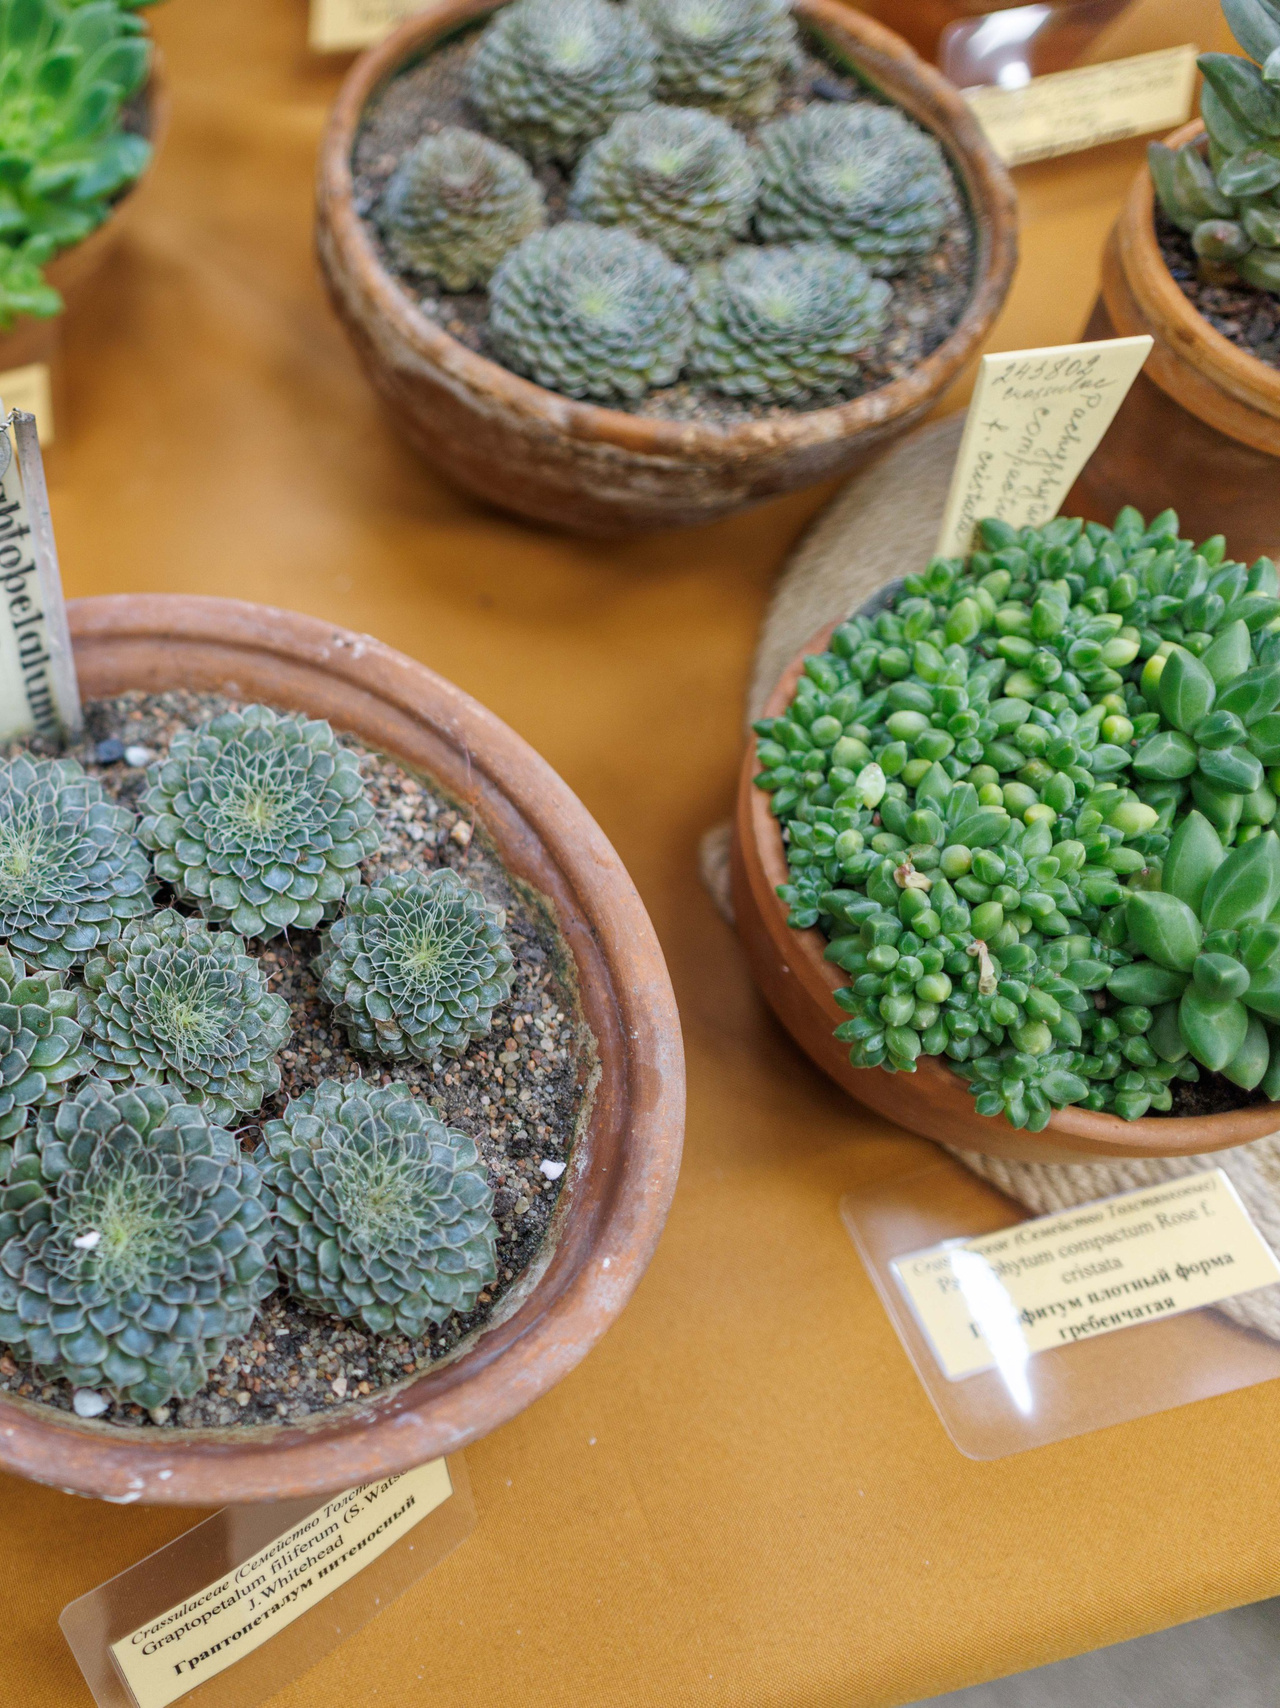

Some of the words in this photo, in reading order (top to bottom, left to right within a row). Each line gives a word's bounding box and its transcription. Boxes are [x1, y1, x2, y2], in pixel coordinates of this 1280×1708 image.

[1058, 1218, 1155, 1262] compactum
[1158, 1207, 1199, 1231] Rose
[1061, 1256, 1125, 1286] cristata
[1087, 1267, 1173, 1307] плотный
[1175, 1250, 1236, 1284] форма
[1058, 1295, 1177, 1341] гребенчатая
[131, 1580, 230, 1646] Crassulaceae
[234, 1517, 320, 1585] (Семейство
[141, 1573, 267, 1658] Graptopetalum
[271, 1521, 340, 1581] filiferum
[343, 1503, 365, 1524] (S.
[172, 1577, 314, 1677] Граптопеталум
[317, 1493, 417, 1580] нитеносный
[248, 1598, 261, 1611] J.
[261, 1534, 345, 1600] Whitehead
